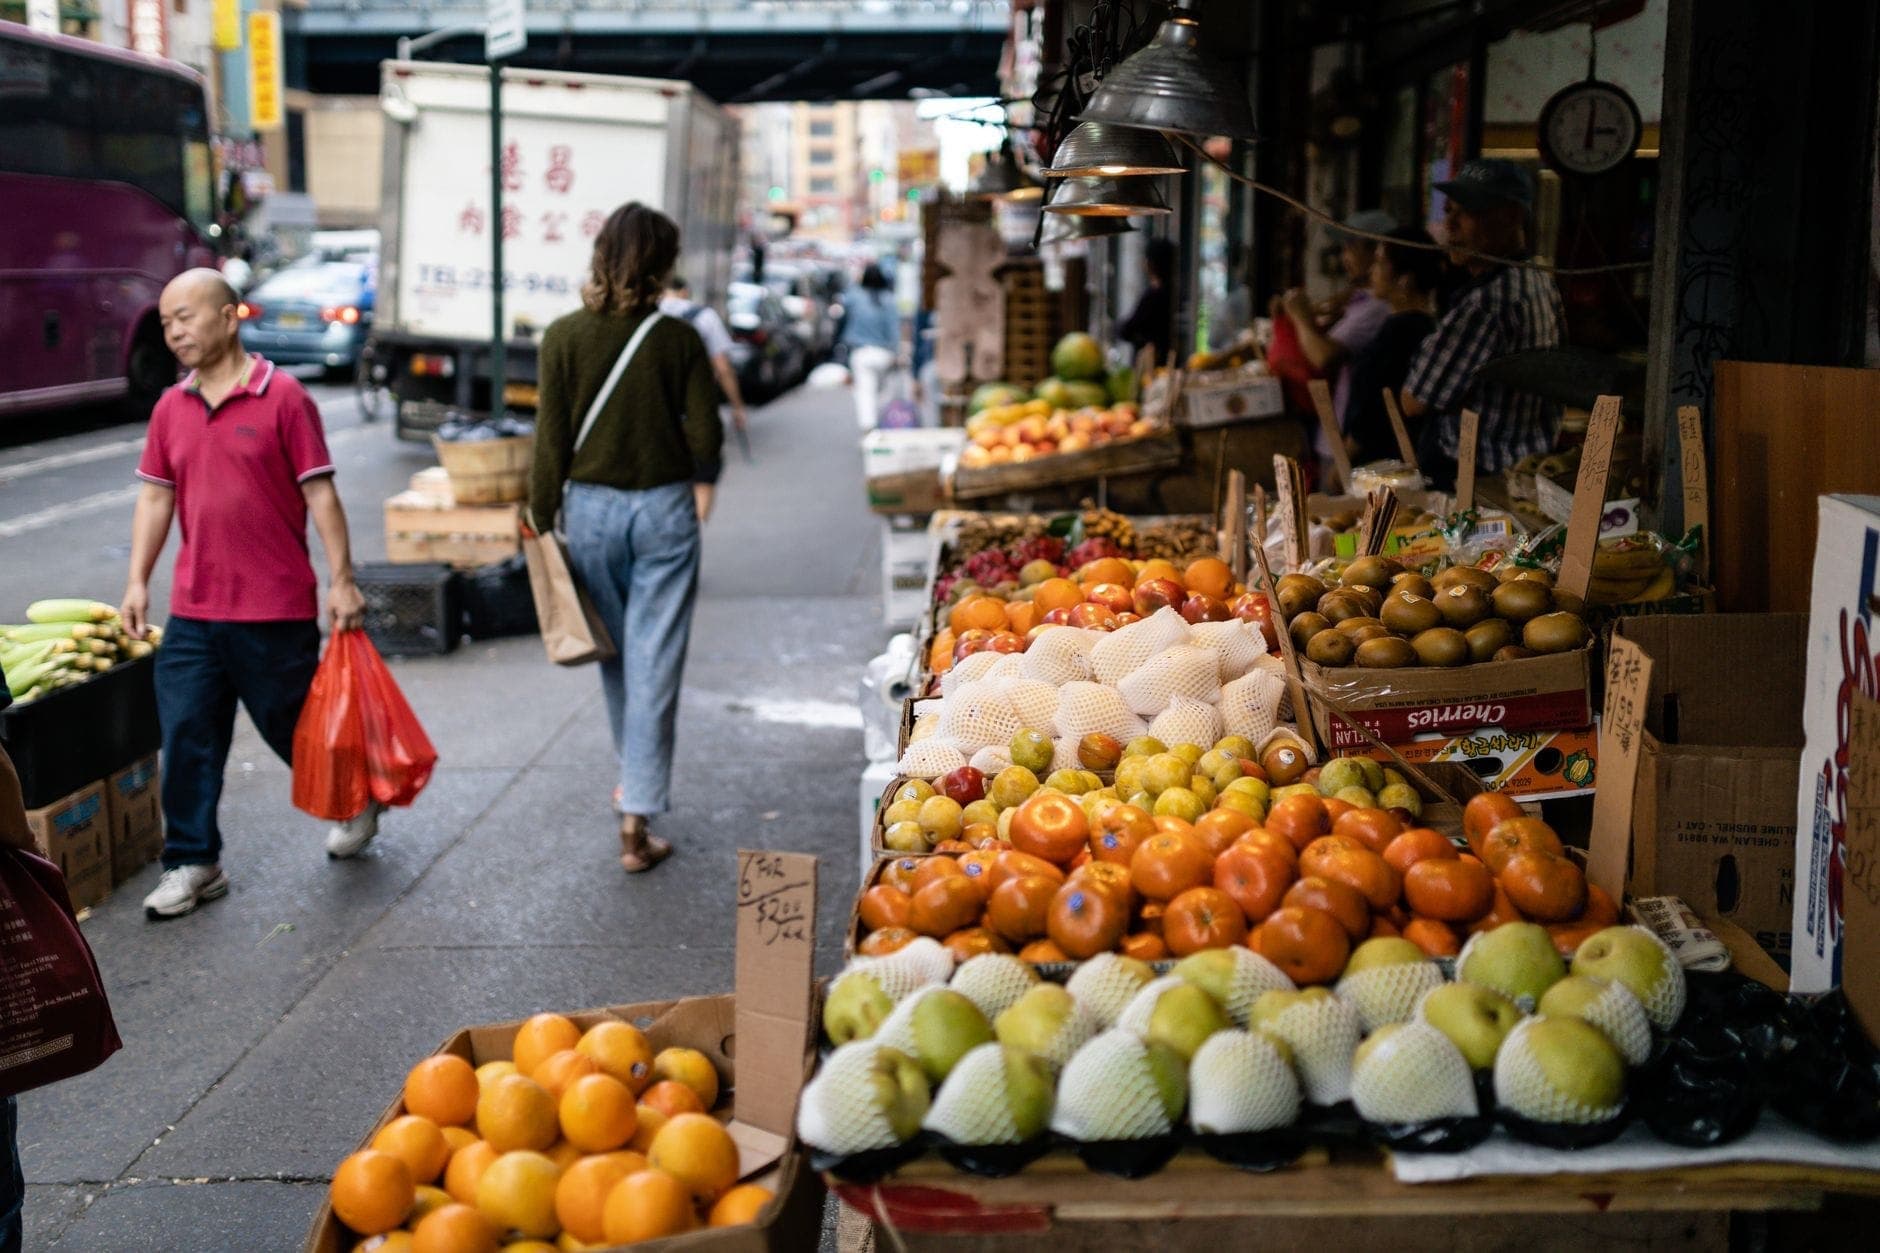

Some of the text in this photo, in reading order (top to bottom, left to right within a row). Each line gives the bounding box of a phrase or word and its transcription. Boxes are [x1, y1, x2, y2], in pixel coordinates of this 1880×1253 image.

[1407, 704, 1507, 729] Cherries
[1335, 727, 1381, 746] CELAN
[1685, 821, 1706, 831] CAT
[1716, 822, 1758, 834] BUSHEL
[1760, 824, 1796, 836] OLUME
[1711, 834, 1729, 845] WA
[1731, 834, 1780, 847] CHELAN,
